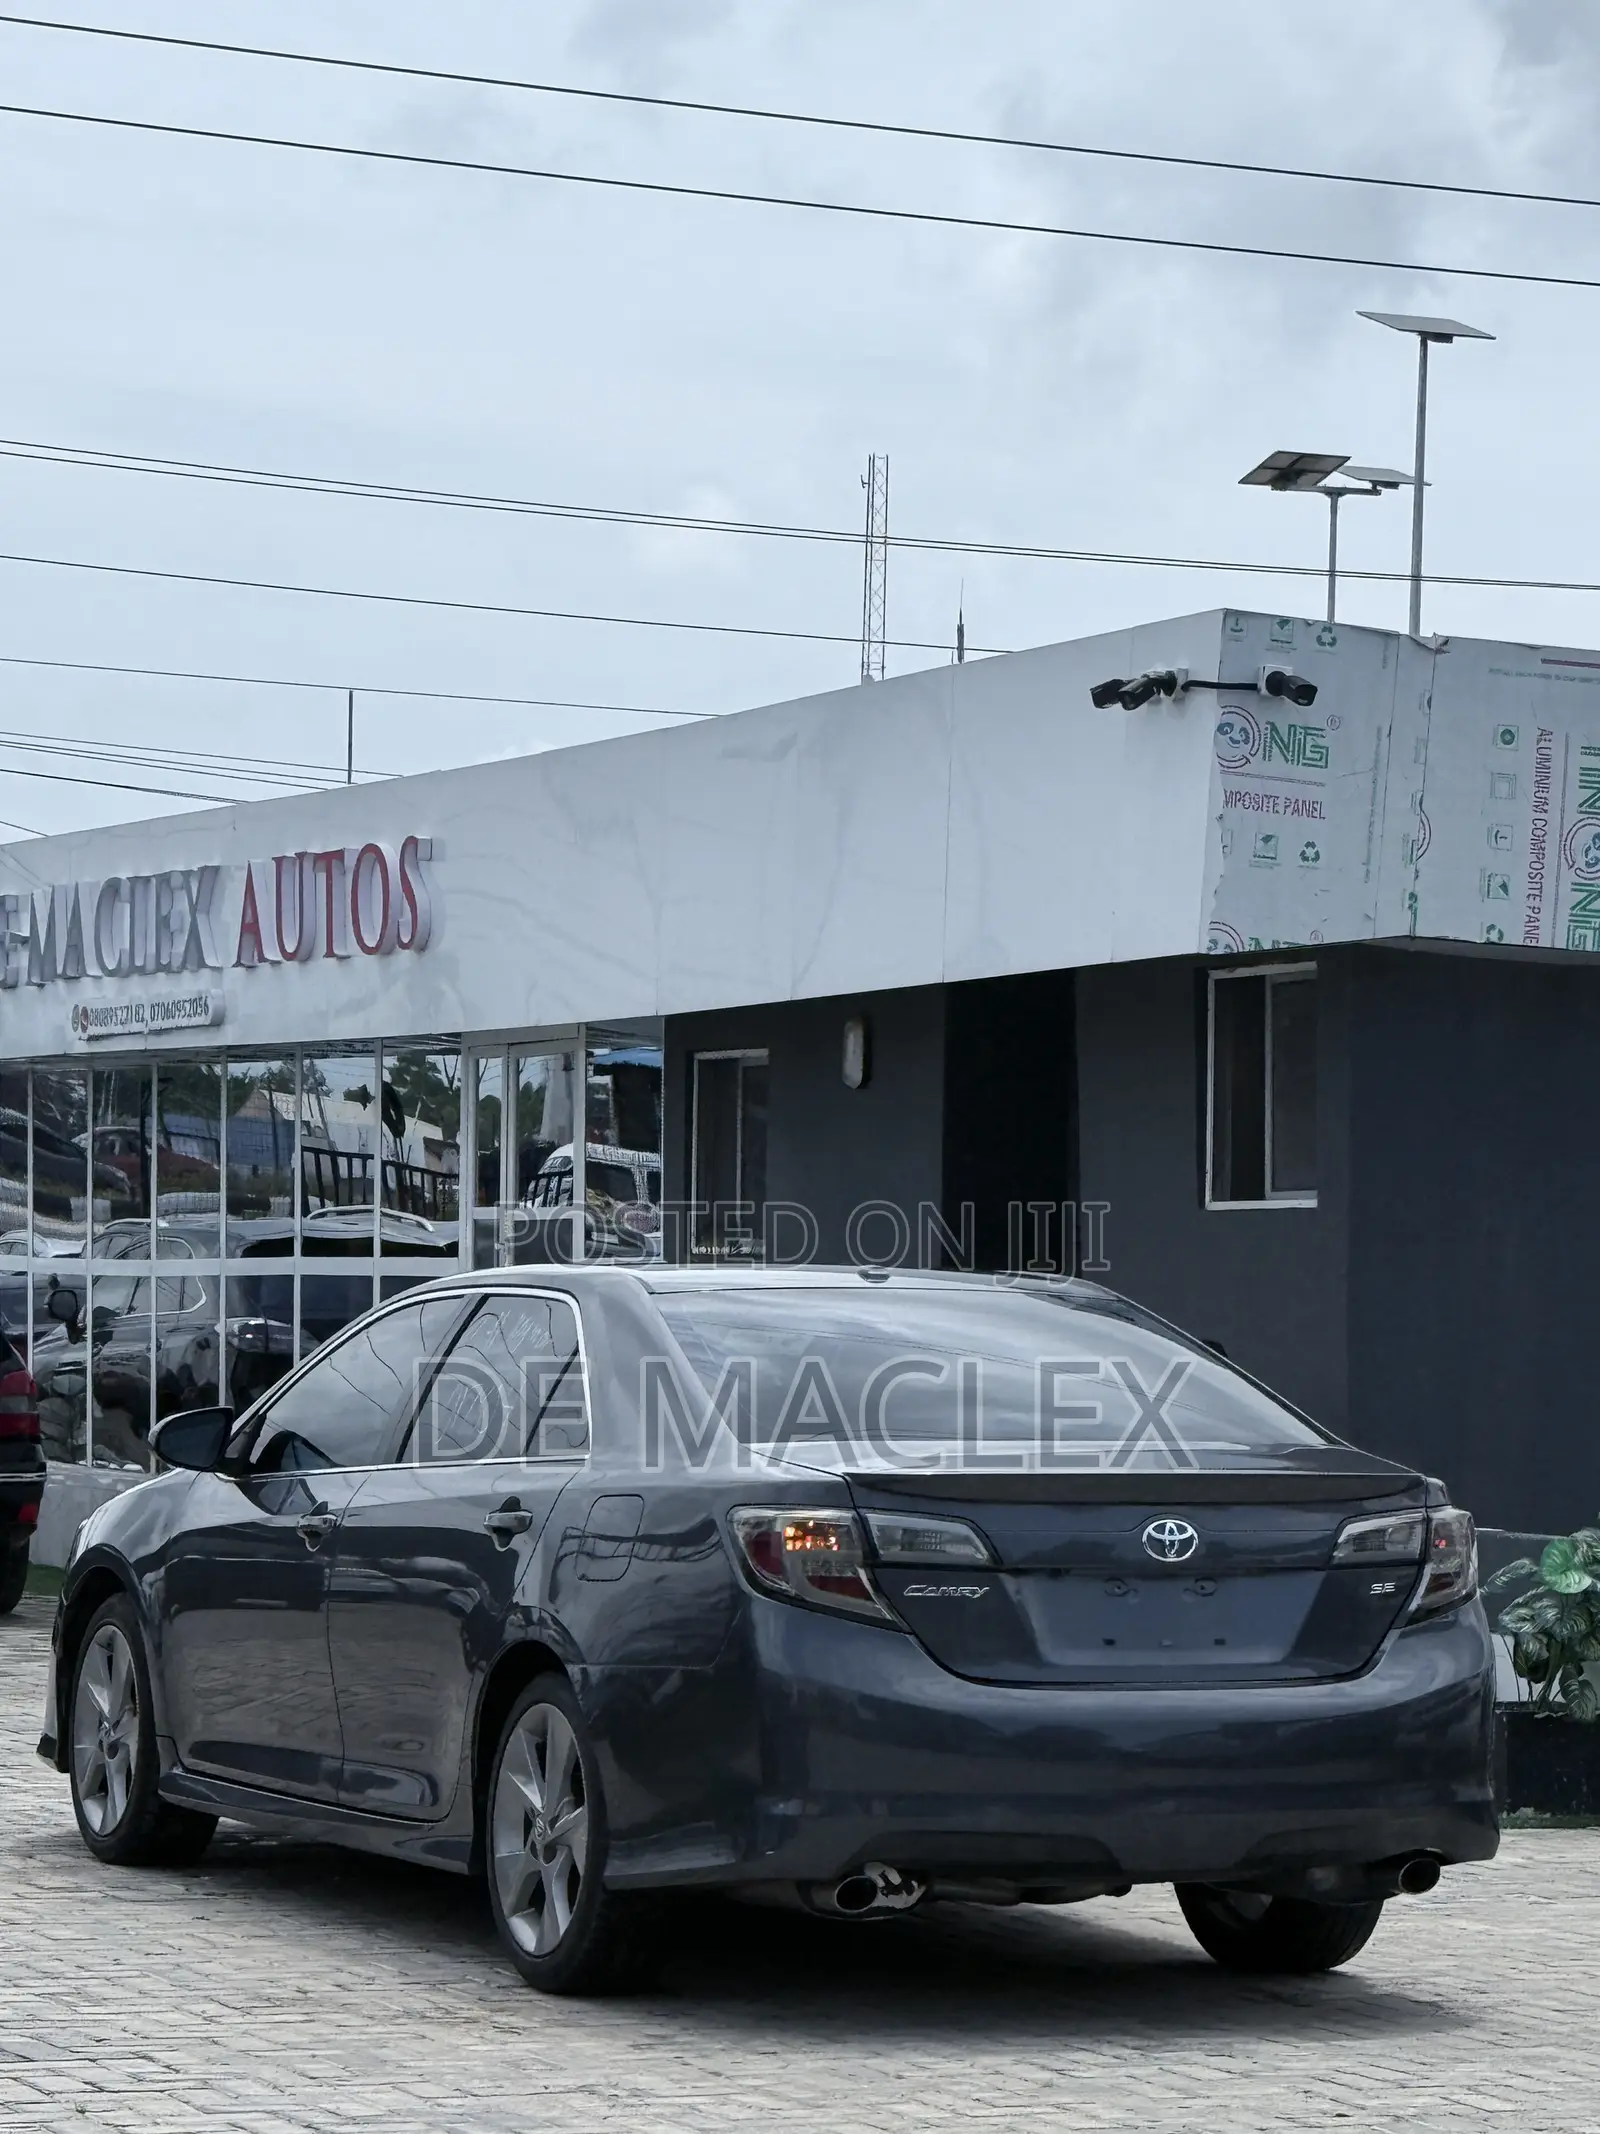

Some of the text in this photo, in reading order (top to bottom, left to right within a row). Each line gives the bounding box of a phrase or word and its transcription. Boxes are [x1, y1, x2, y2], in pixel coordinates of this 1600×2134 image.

[1283, 796, 1327, 820] PANEL
[1531, 725, 1553, 814] ALUMINIUM
[231, 834, 431, 968] AUTOS
[1525, 817, 1548, 903] COMPOSITE
[1370, 1582, 1396, 1594] SE
